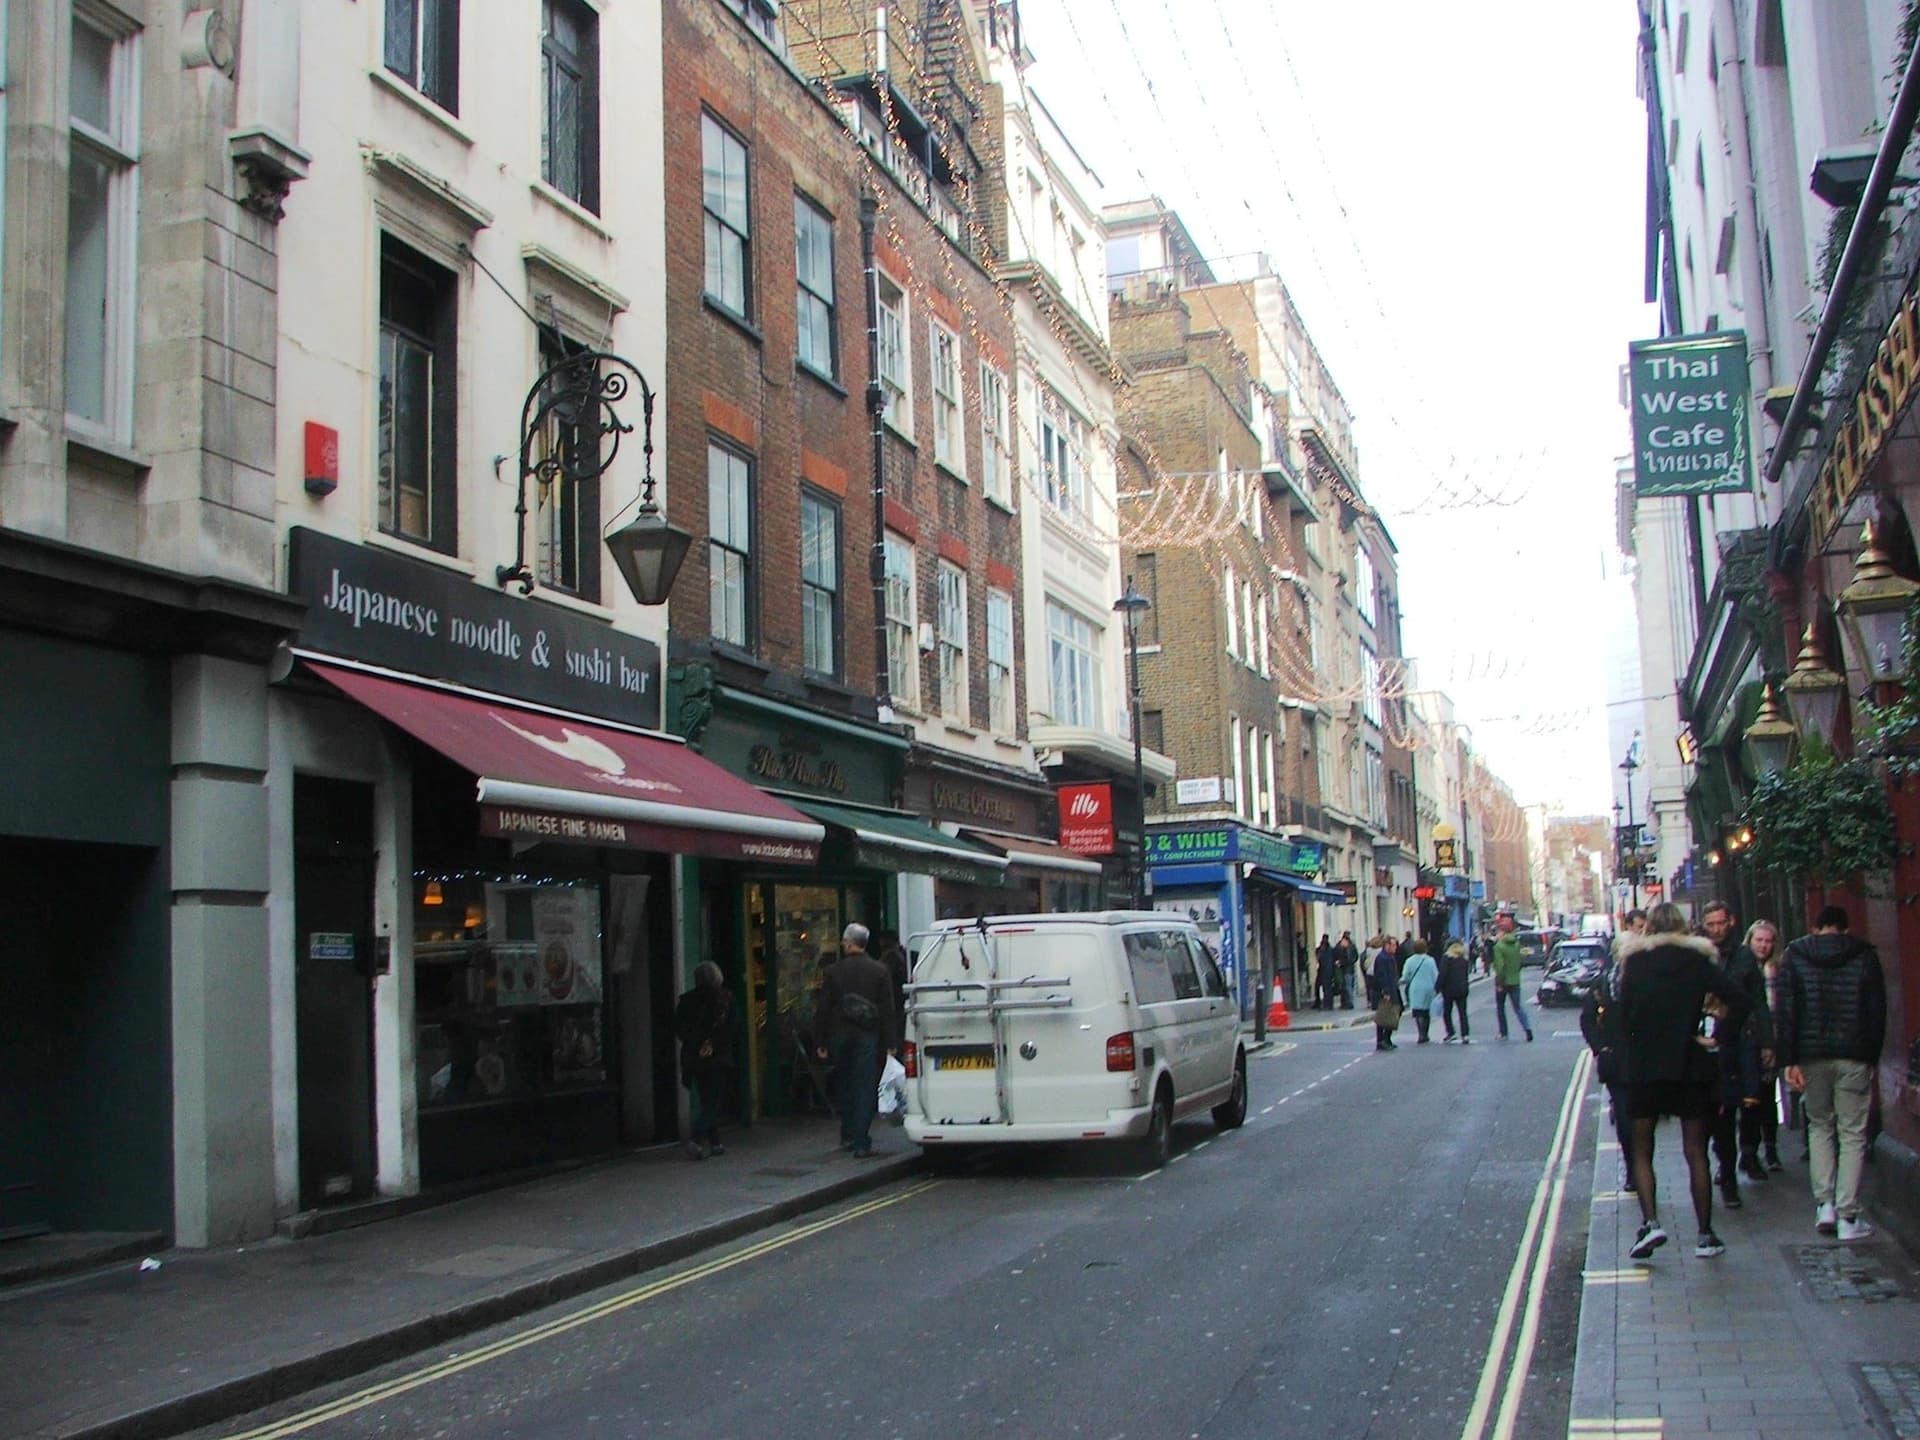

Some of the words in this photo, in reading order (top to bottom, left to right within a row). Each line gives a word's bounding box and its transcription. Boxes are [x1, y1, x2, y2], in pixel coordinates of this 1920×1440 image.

[1645, 355, 1718, 380] Thai
[1641, 391, 1728, 415] West
[1647, 423, 1725, 448] Cafe
[324, 568, 438, 637] Japanese
[451, 617, 521, 660] noodle
[531, 630, 550, 668] &
[566, 648, 611, 684] sushi
[620, 656, 649, 694] bar
[1070, 793, 1099, 819] illy
[500, 811, 559, 835] JAPANESE
[561, 818, 587, 838] FINE
[589, 821, 626, 841] RAMEN
[1158, 835, 1171, 851] &
[1176, 831, 1228, 849] WINE
